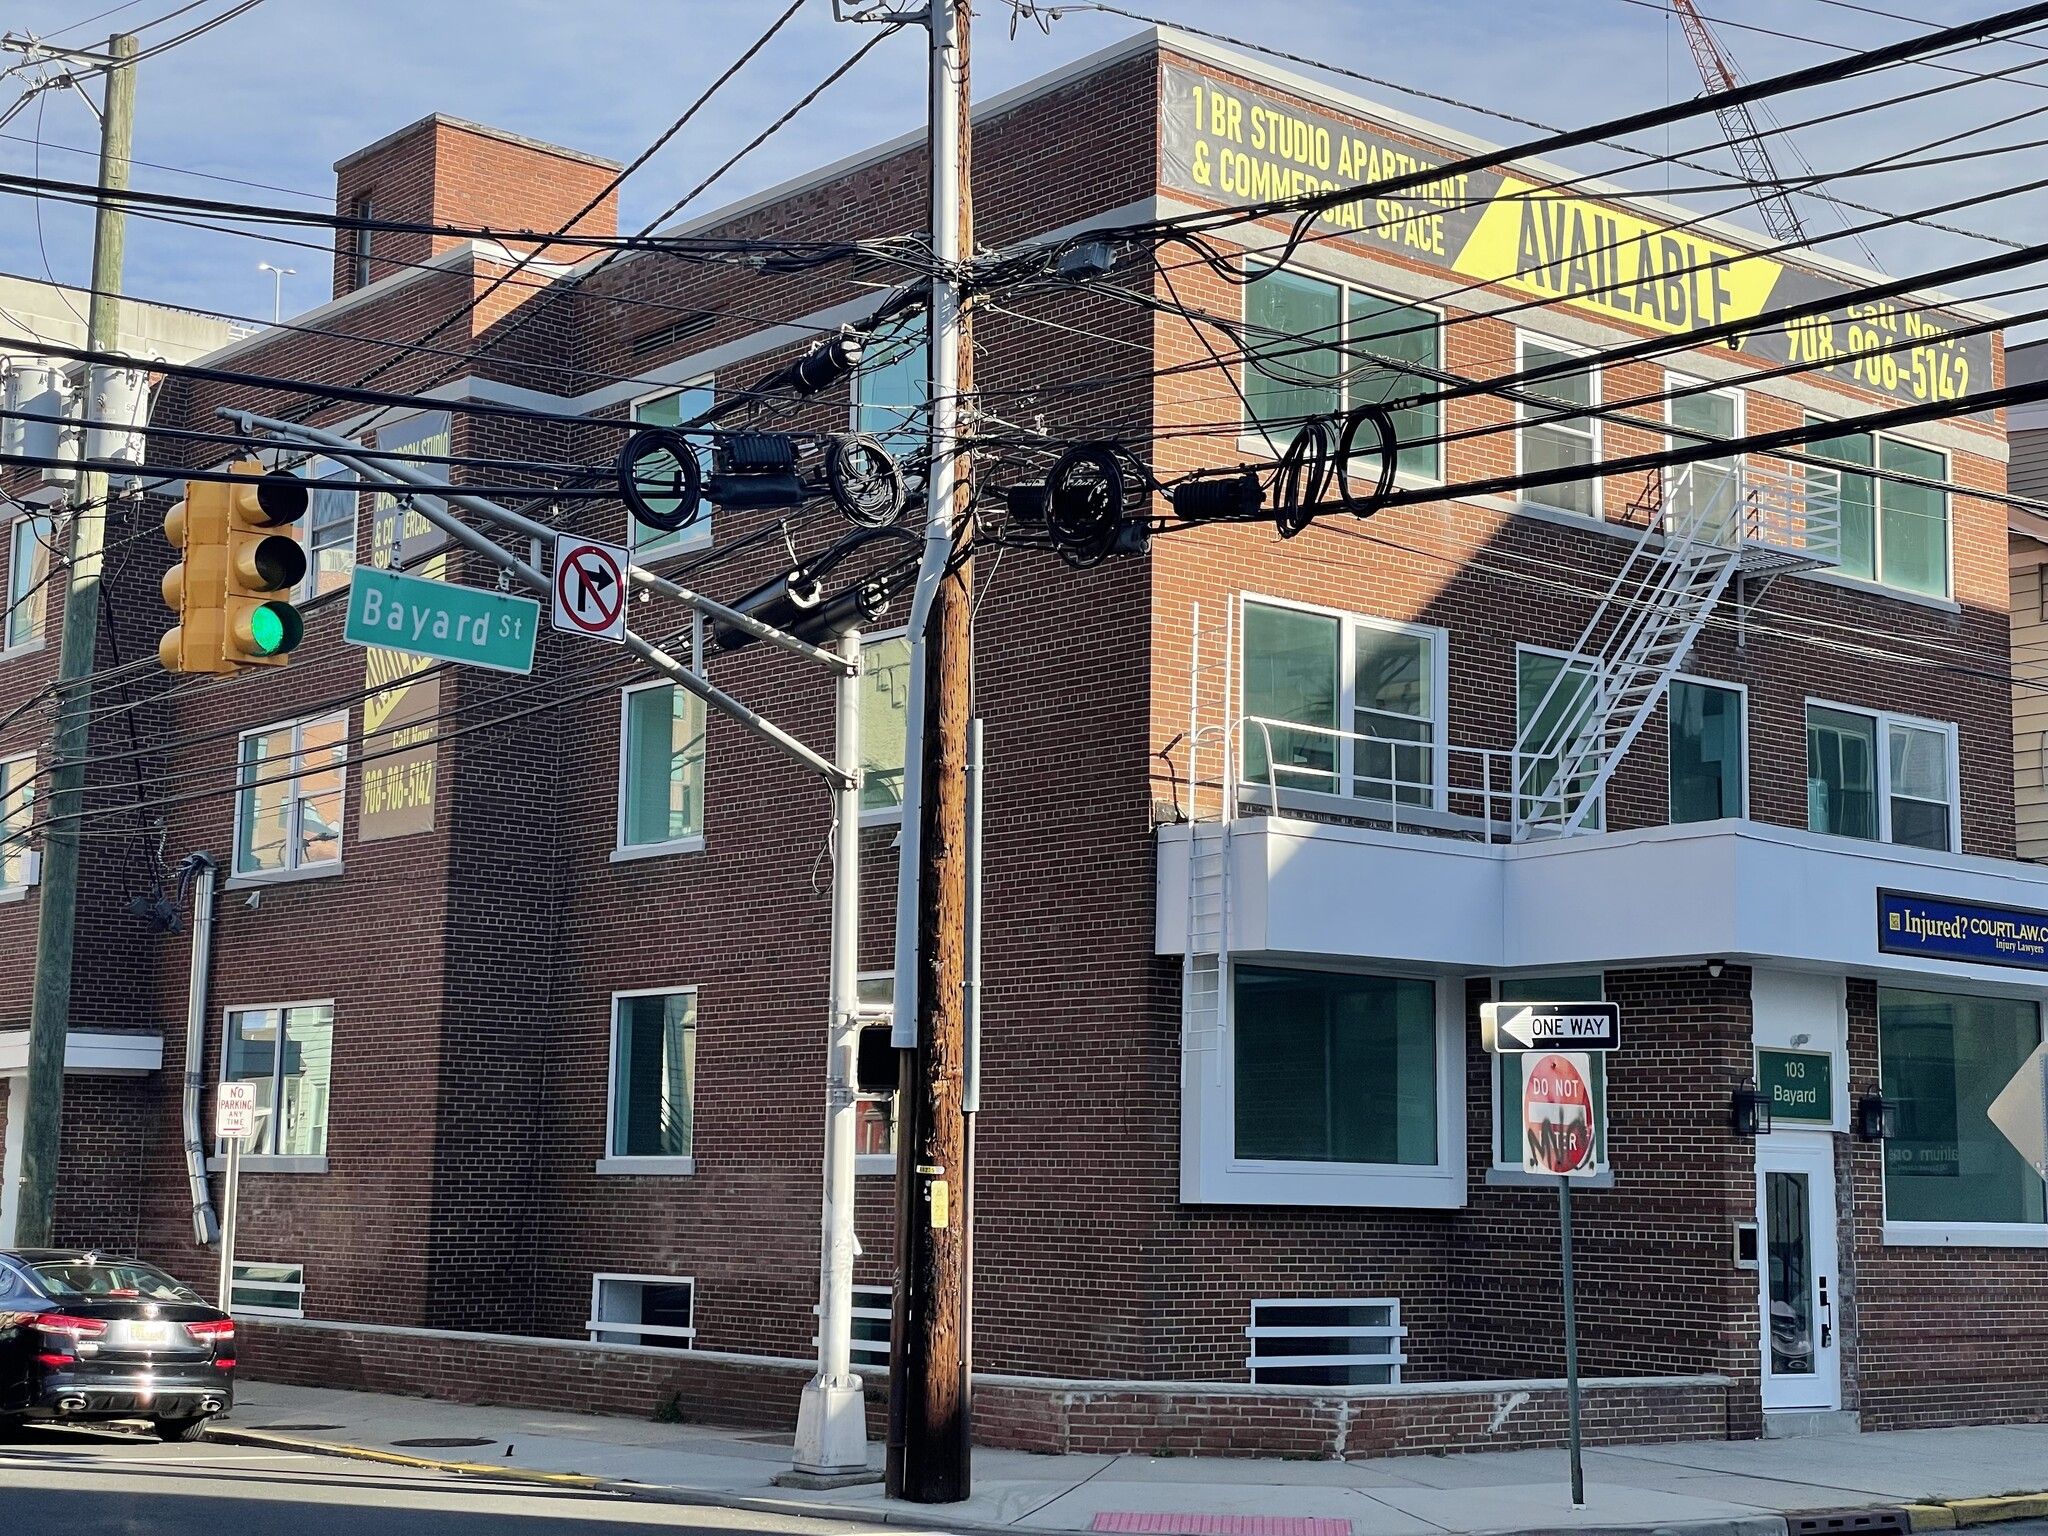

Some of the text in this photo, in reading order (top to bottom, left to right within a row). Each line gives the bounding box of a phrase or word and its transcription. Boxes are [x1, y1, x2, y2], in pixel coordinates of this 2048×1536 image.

[1192, 86, 1469, 214] 1 BR STUDIO APARTMENT
[1192, 140, 1213, 187] &
[1376, 199, 1446, 257] SPACE
[1516, 192, 1731, 330] AVAILABLE
[1784, 305, 1968, 402] 908-906-5142
[374, 510, 432, 548] & COERCIAL
[362, 588, 522, 646] Bayard St
[392, 728, 411, 749] Call
[364, 759, 433, 815] 908-906-5142
[1904, 909, 1968, 942] Injured?
[1995, 938, 2045, 956] Injury Lawyers
[1532, 1018, 1605, 1036] ONE WAY
[1784, 1061, 1805, 1078] 103
[230, 1088, 244, 1098] NO
[1533, 1077, 1579, 1098] DO NOT
[1773, 1085, 1816, 1106] Bayard
[220, 1099, 252, 1110] PARKING
[227, 1118, 244, 1126] TIME
